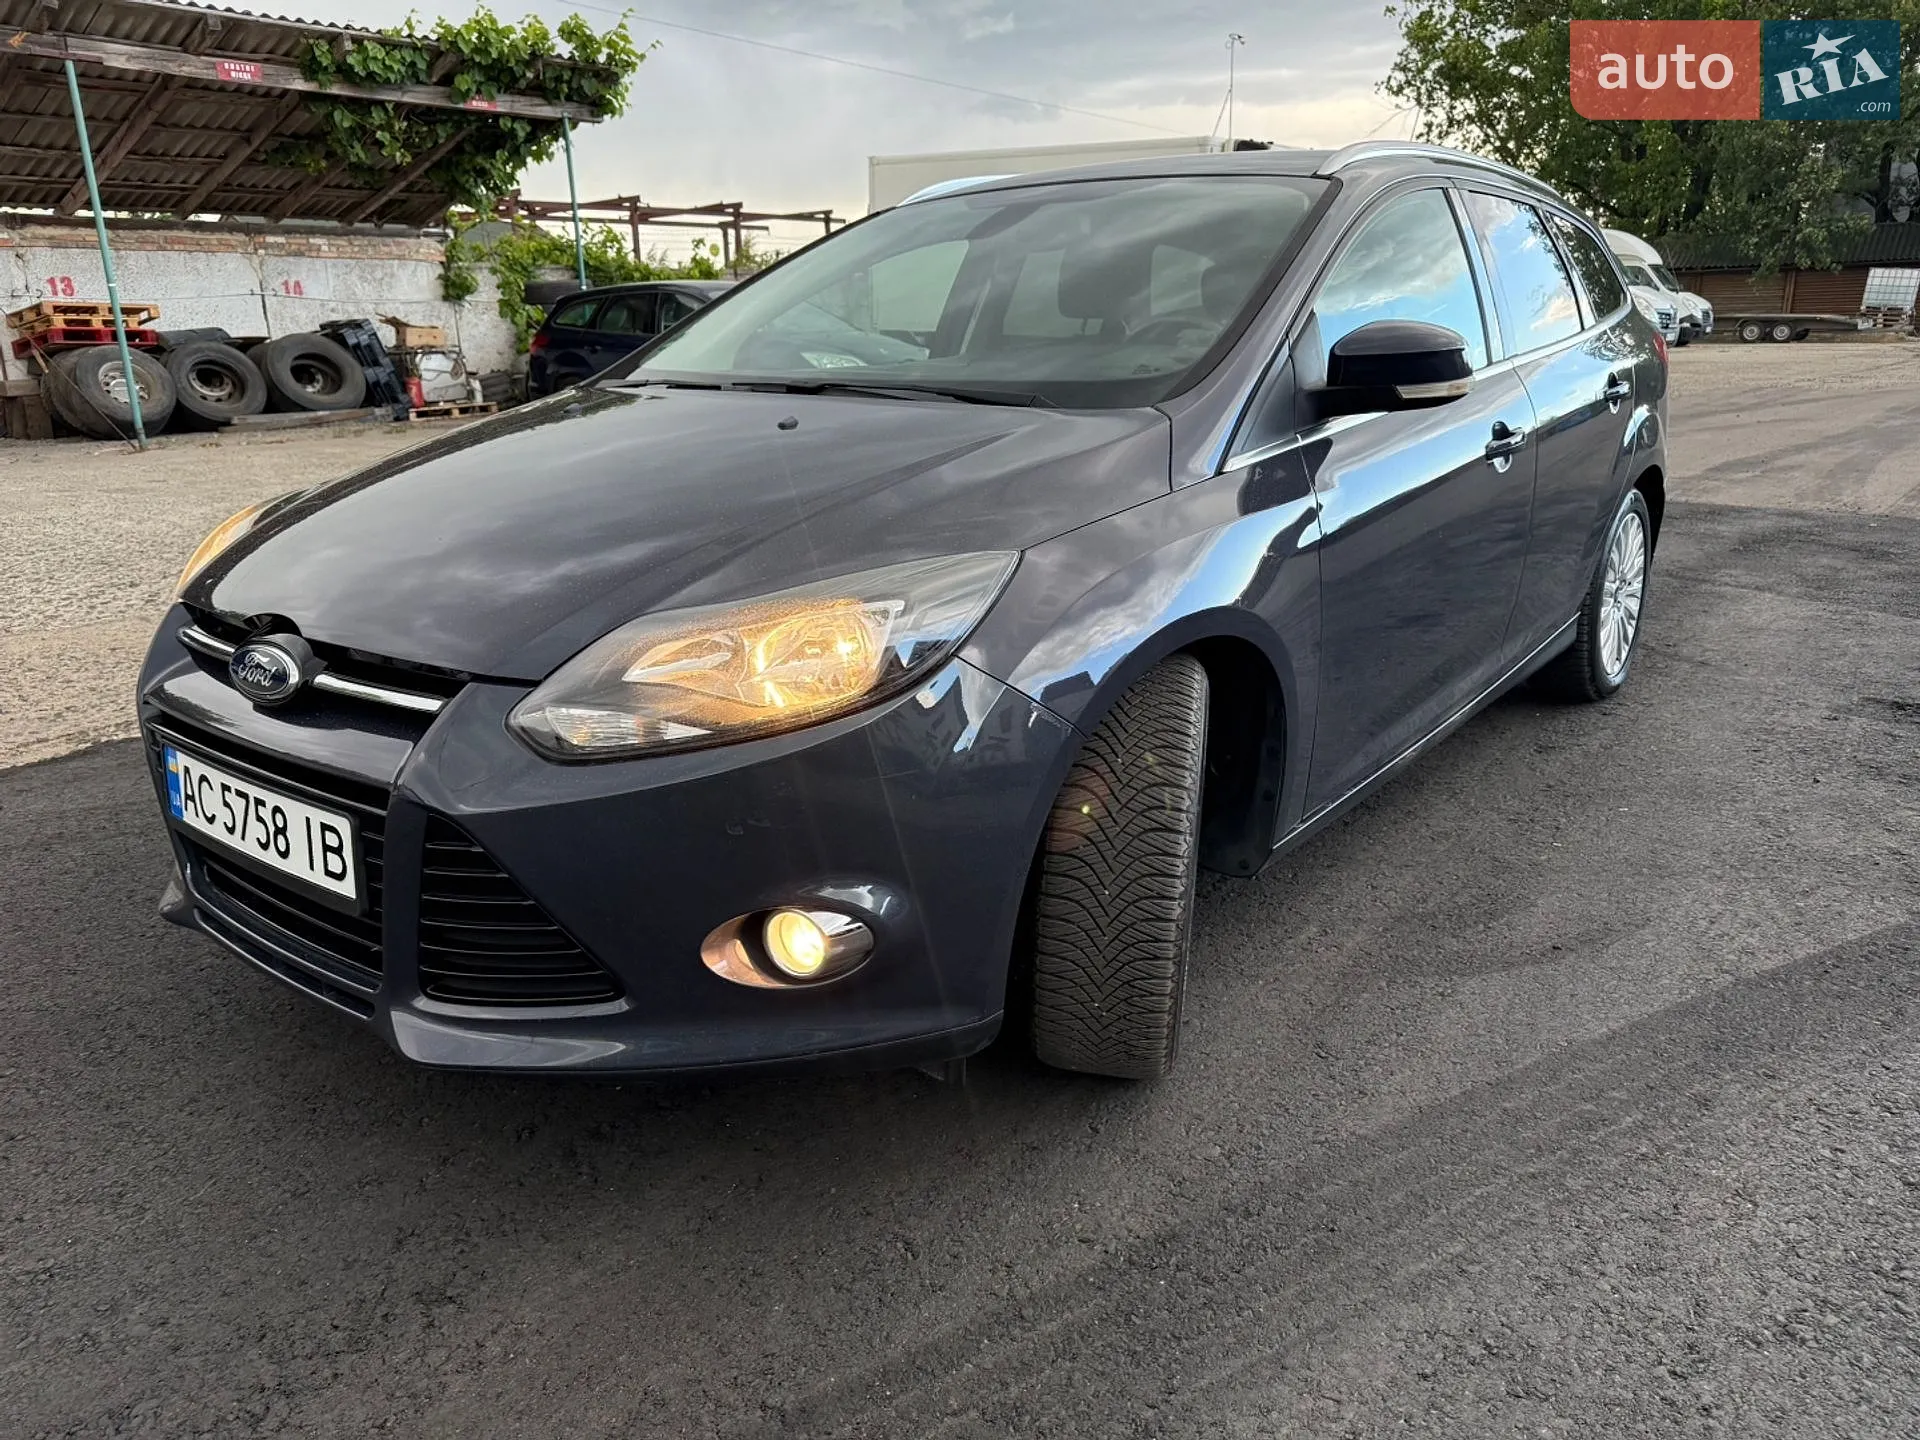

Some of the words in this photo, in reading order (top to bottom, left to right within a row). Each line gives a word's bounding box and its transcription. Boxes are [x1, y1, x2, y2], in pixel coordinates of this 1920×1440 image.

[46, 275, 75, 297] 13
[238, 651, 278, 687] Ford
[183, 765, 217, 826] AC
[220, 781, 292, 860] 5758
[305, 815, 348, 882] IB
